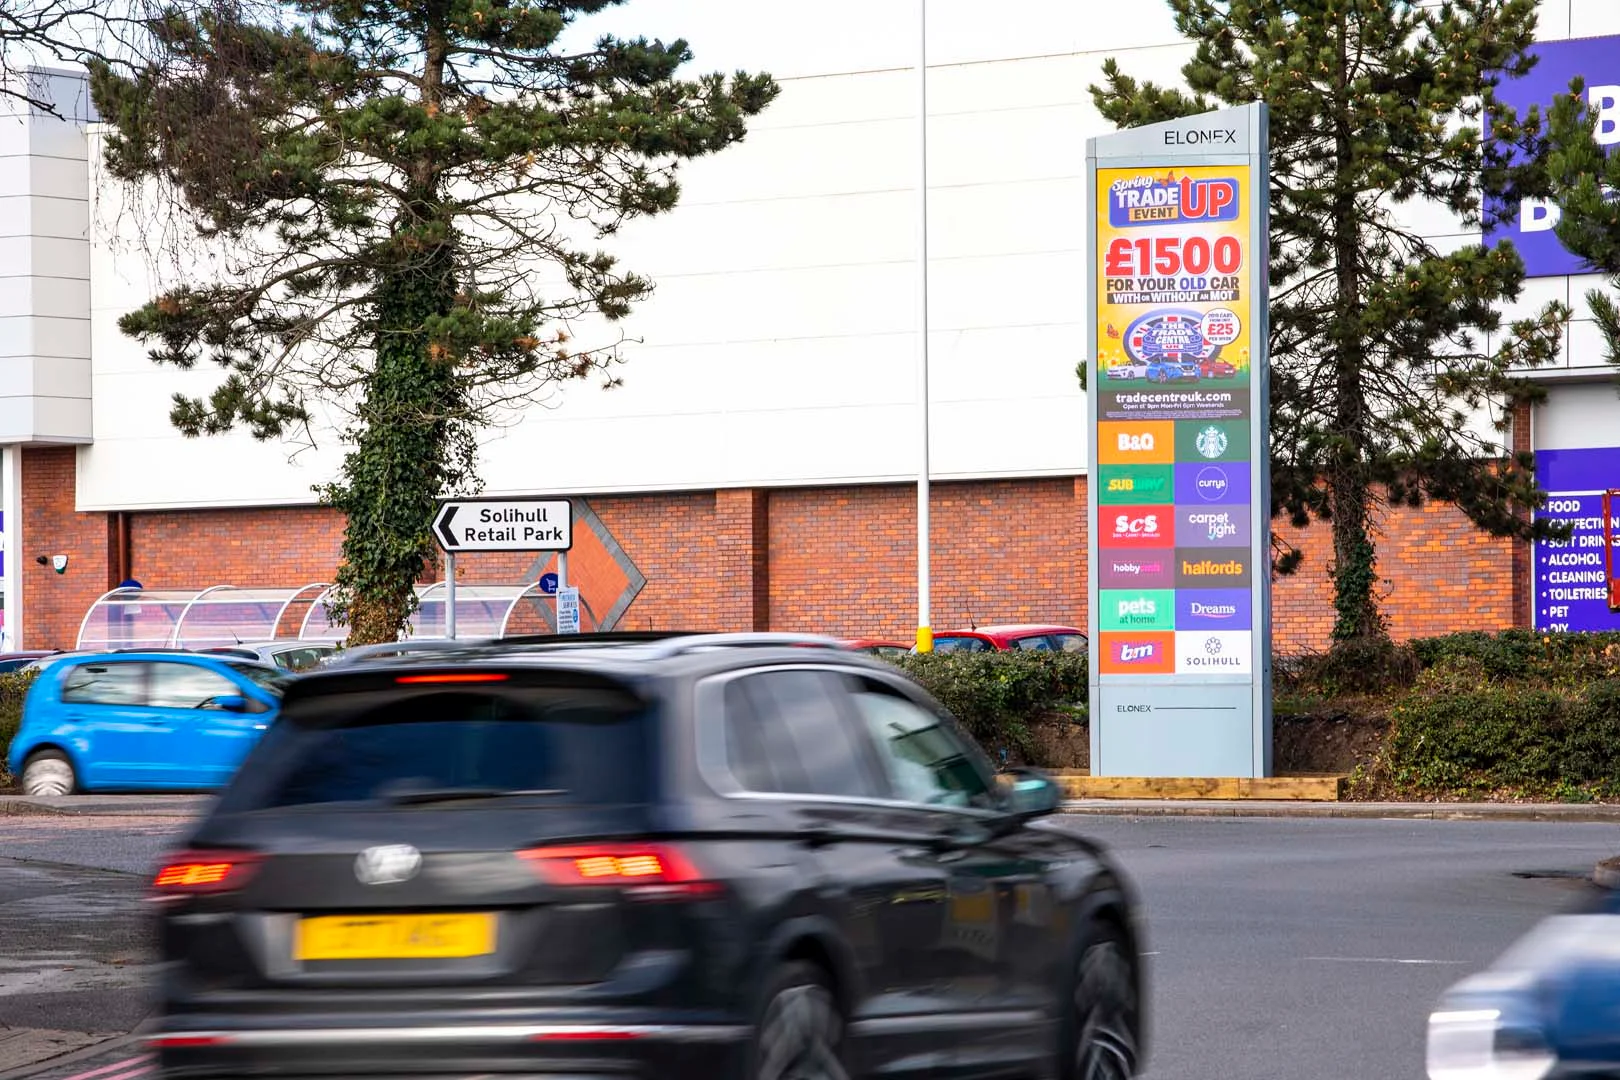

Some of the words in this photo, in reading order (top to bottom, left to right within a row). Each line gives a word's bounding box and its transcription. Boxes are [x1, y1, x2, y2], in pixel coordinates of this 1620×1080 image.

[1165, 130, 1236, 144] ELONEX
[1112, 176, 1155, 193] Spring
[1117, 187, 1179, 209] TRADE
[1180, 176, 1233, 218] UP
[1134, 206, 1175, 220] EVENT
[1106, 236, 1243, 277] £1500
[1107, 279, 1134, 291] FOR
[1137, 278, 1176, 291] YOUR
[1179, 277, 1207, 290] OLD
[1210, 276, 1240, 289] CAR
[1113, 293, 1142, 304] WITH
[1150, 292, 1200, 303] WITHOUT
[1210, 291, 1234, 301] MOT
[1207, 323, 1234, 336] £25
[1115, 392, 1232, 403] tradecentreuk.com
[1117, 432, 1155, 451] B&Q
[1108, 478, 1164, 491] SUBWAY
[1198, 479, 1226, 489] currys
[1548, 500, 1581, 513] FOOD
[480, 508, 548, 523] Solihull
[1188, 512, 1229, 526] carpet
[1115, 515, 1158, 533] ScS
[1208, 522, 1237, 538] right
[1548, 517, 1620, 530] COFECTIN
[465, 527, 517, 542] Retail
[524, 527, 563, 541] Park
[1579, 535, 1620, 548] DRINS
[1548, 553, 1602, 566] ALCOHOL
[1183, 560, 1243, 575] halfords
[1548, 571, 1606, 583] CLEANING
[1548, 587, 1609, 600] TOILETRIES
[1118, 598, 1156, 616] pets
[1191, 602, 1236, 614] Dreams
[1549, 606, 1569, 618] PET
[1119, 615, 1128, 624] at
[1130, 615, 1155, 624] home
[1186, 657, 1241, 666] SOLIHULL
[1117, 704, 1151, 713] ELONEX
